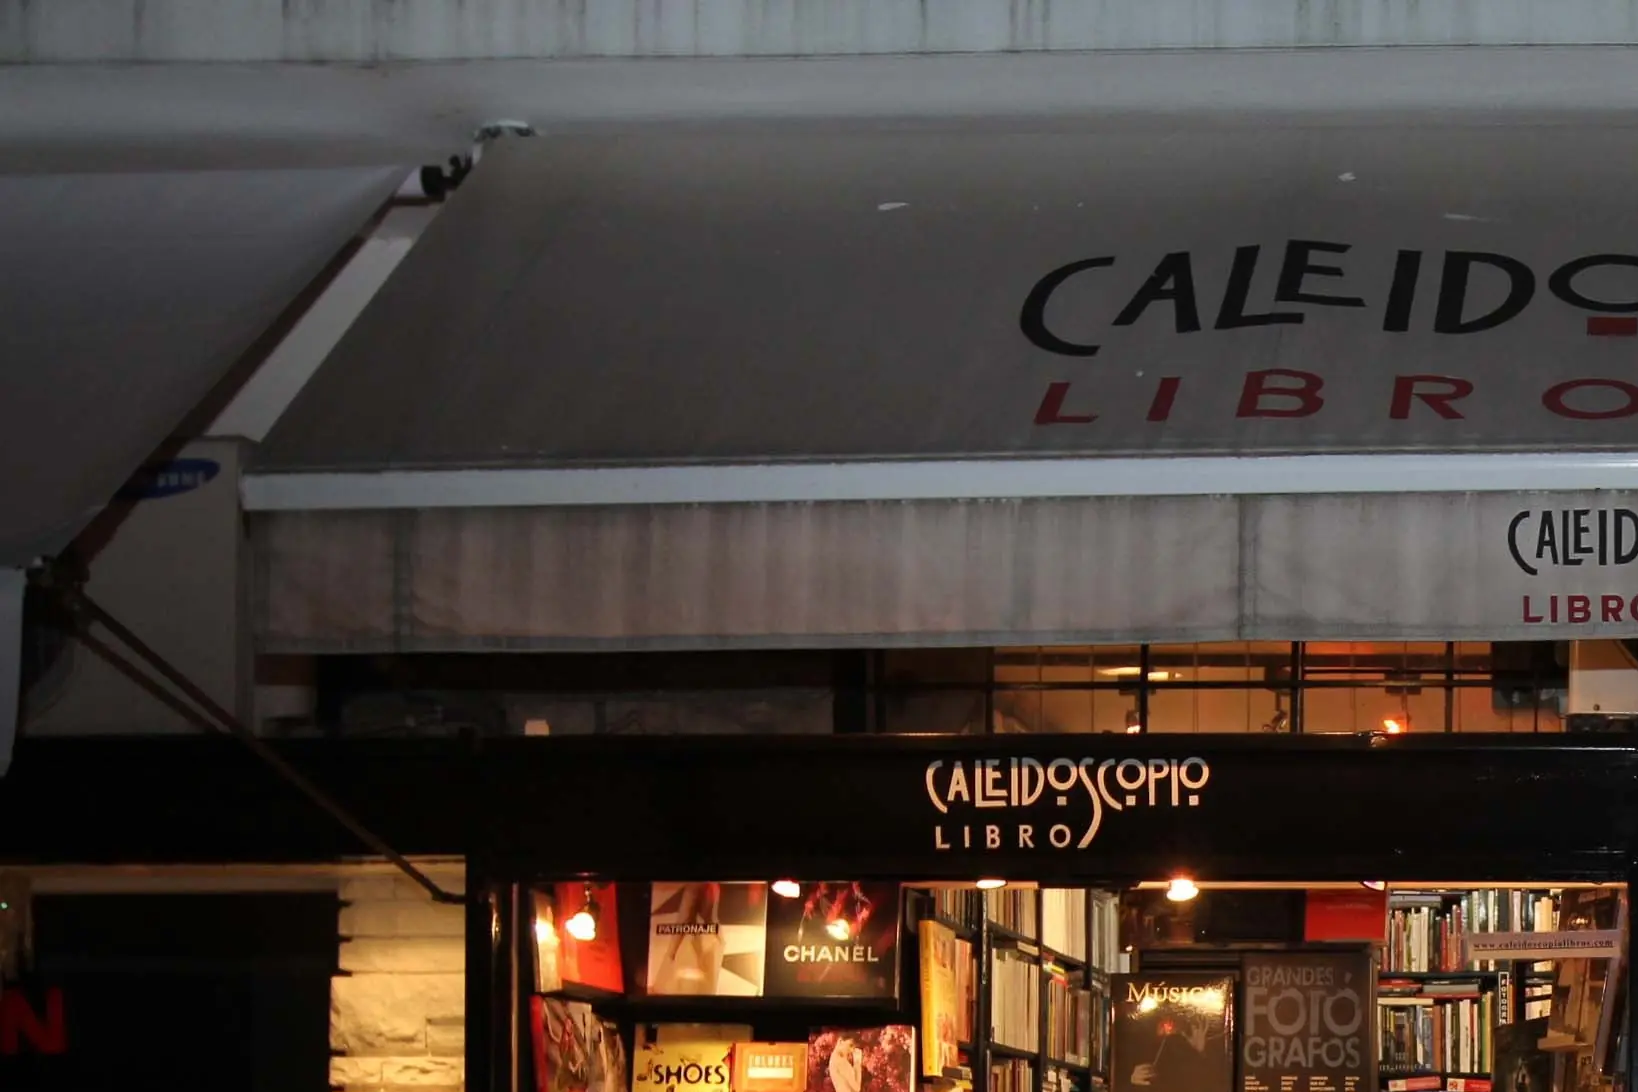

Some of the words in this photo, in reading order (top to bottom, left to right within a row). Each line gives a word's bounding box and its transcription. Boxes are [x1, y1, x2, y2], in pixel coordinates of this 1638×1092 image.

[925, 756, 1210, 848] CALEIDOSCOPIO
[783, 943, 880, 963] CHANEL
[1246, 966, 1335, 986] GRANDES
[1244, 1036, 1361, 1068] GRAFOS
[652, 1061, 726, 1085] SHOES
